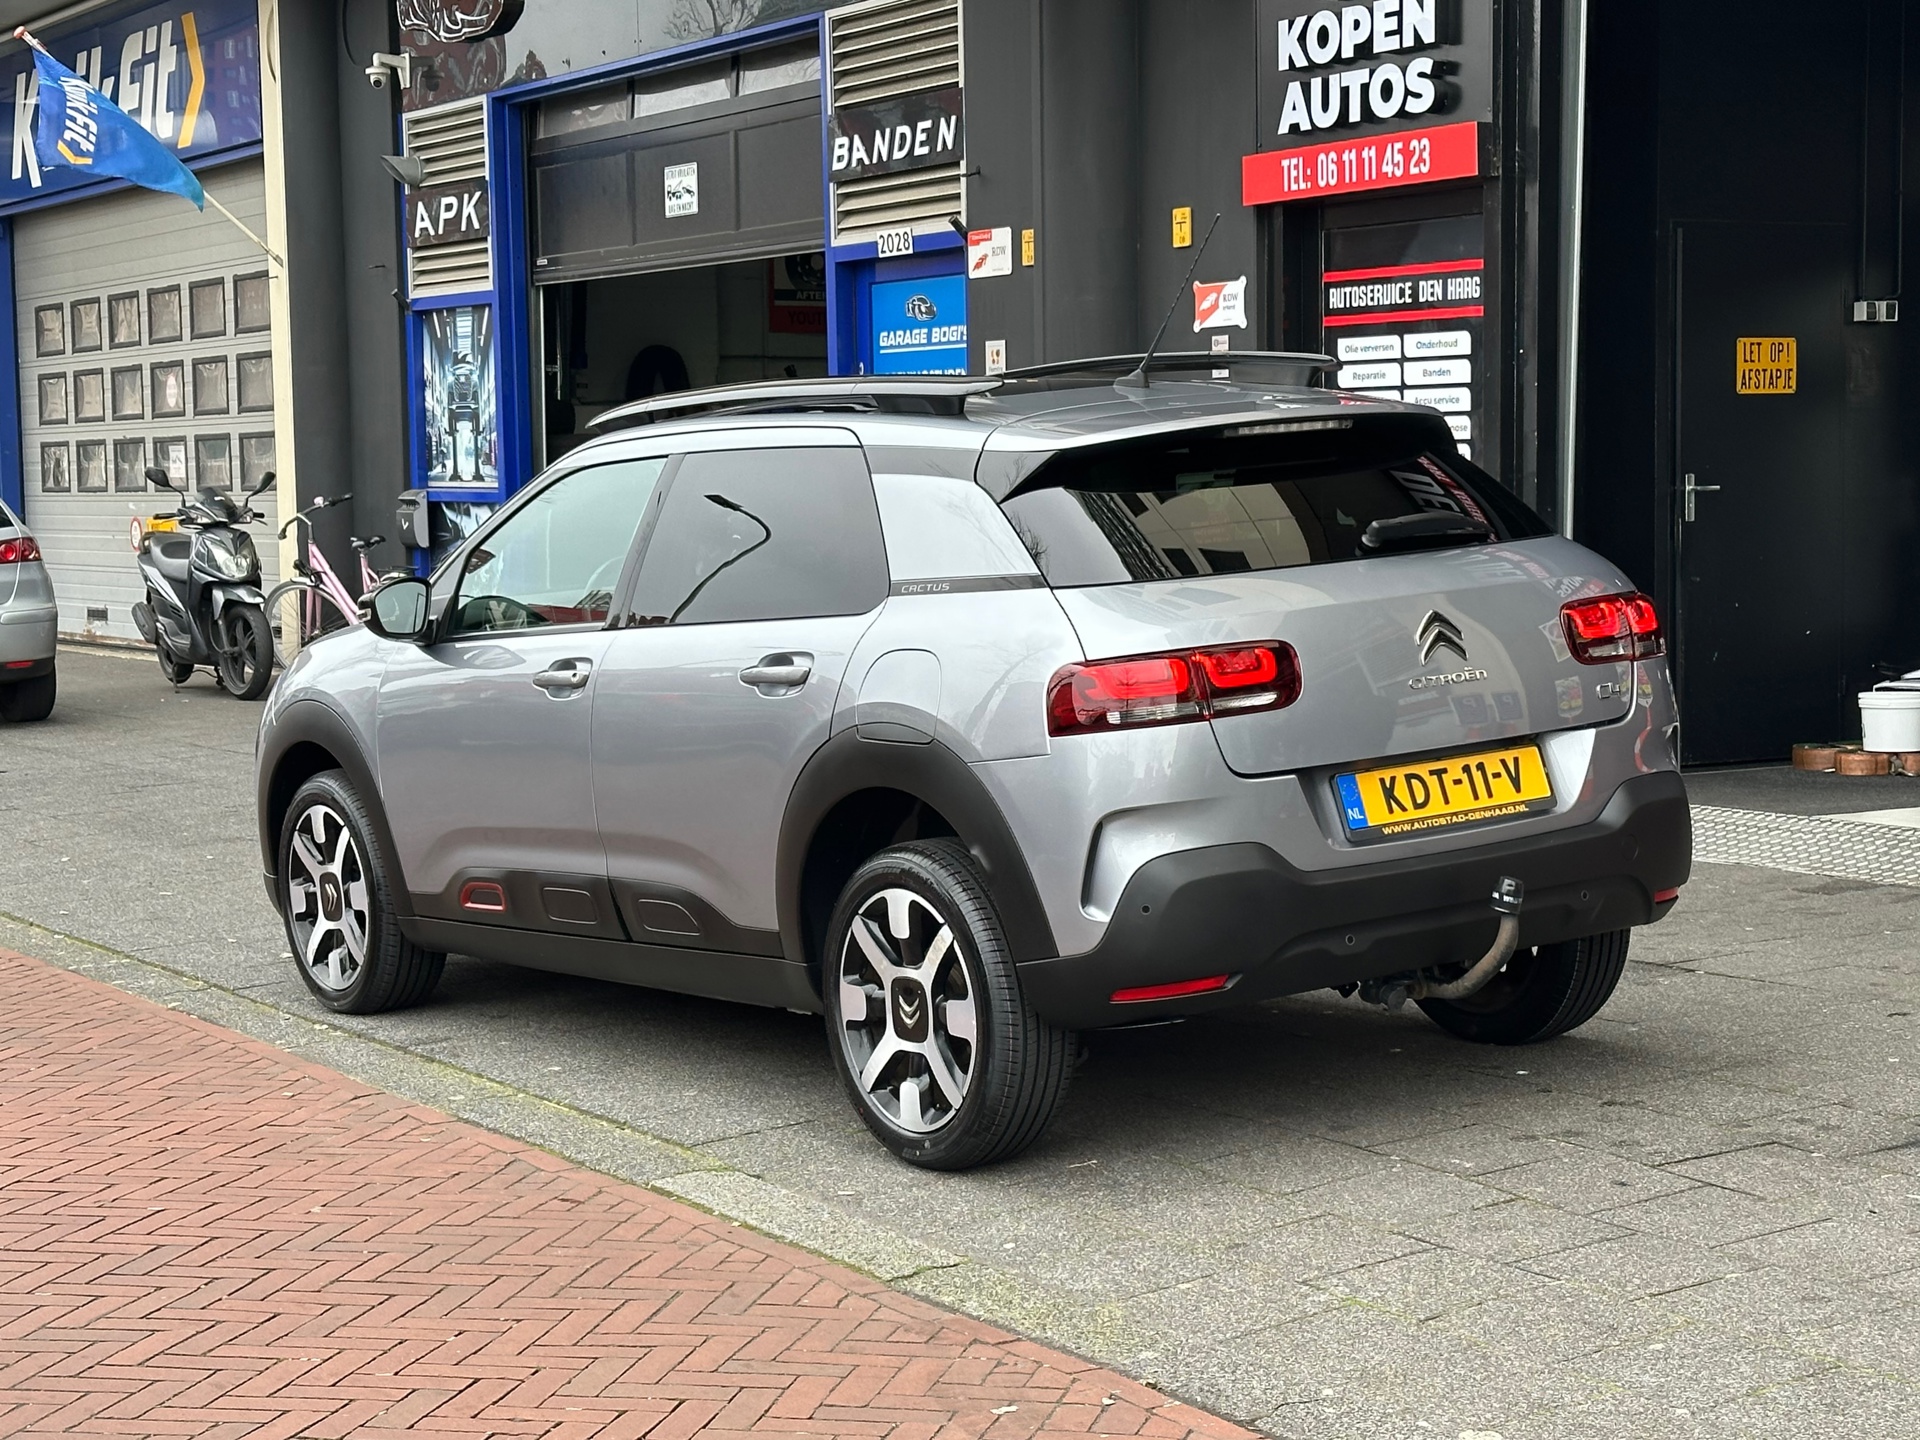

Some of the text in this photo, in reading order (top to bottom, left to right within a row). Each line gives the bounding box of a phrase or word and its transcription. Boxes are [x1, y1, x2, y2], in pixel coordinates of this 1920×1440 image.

[1277, 0, 1436, 71] KOPEN
[1277, 57, 1436, 135] AUTOS
[832, 115, 957, 171] BANDEN
[1281, 137, 1431, 192] TEL: 06 11 11 45 23
[414, 191, 482, 238] APK
[879, 231, 911, 254] 2028
[1329, 276, 1481, 309] AUTOSERVICE DEN HAAG
[879, 328, 928, 347] GARAGE
[1344, 343, 1395, 354] Olie verversen
[1415, 338, 1458, 350] Onderhoud
[1742, 341, 1790, 363] LET OP!
[1352, 370, 1386, 382] Reparatie
[1422, 368, 1451, 378] Banden
[1740, 368, 1793, 390] AFSTAPJE
[1433, 394, 1460, 405] service
[901, 582, 950, 593] CACTUS
[1595, 681, 1621, 700] C4
[1378, 756, 1521, 815] KDT-11-V
[1347, 807, 1365, 821] NL
[1382, 804, 1530, 836] WWW.AUTOSTAD-DENHAAG.NL
